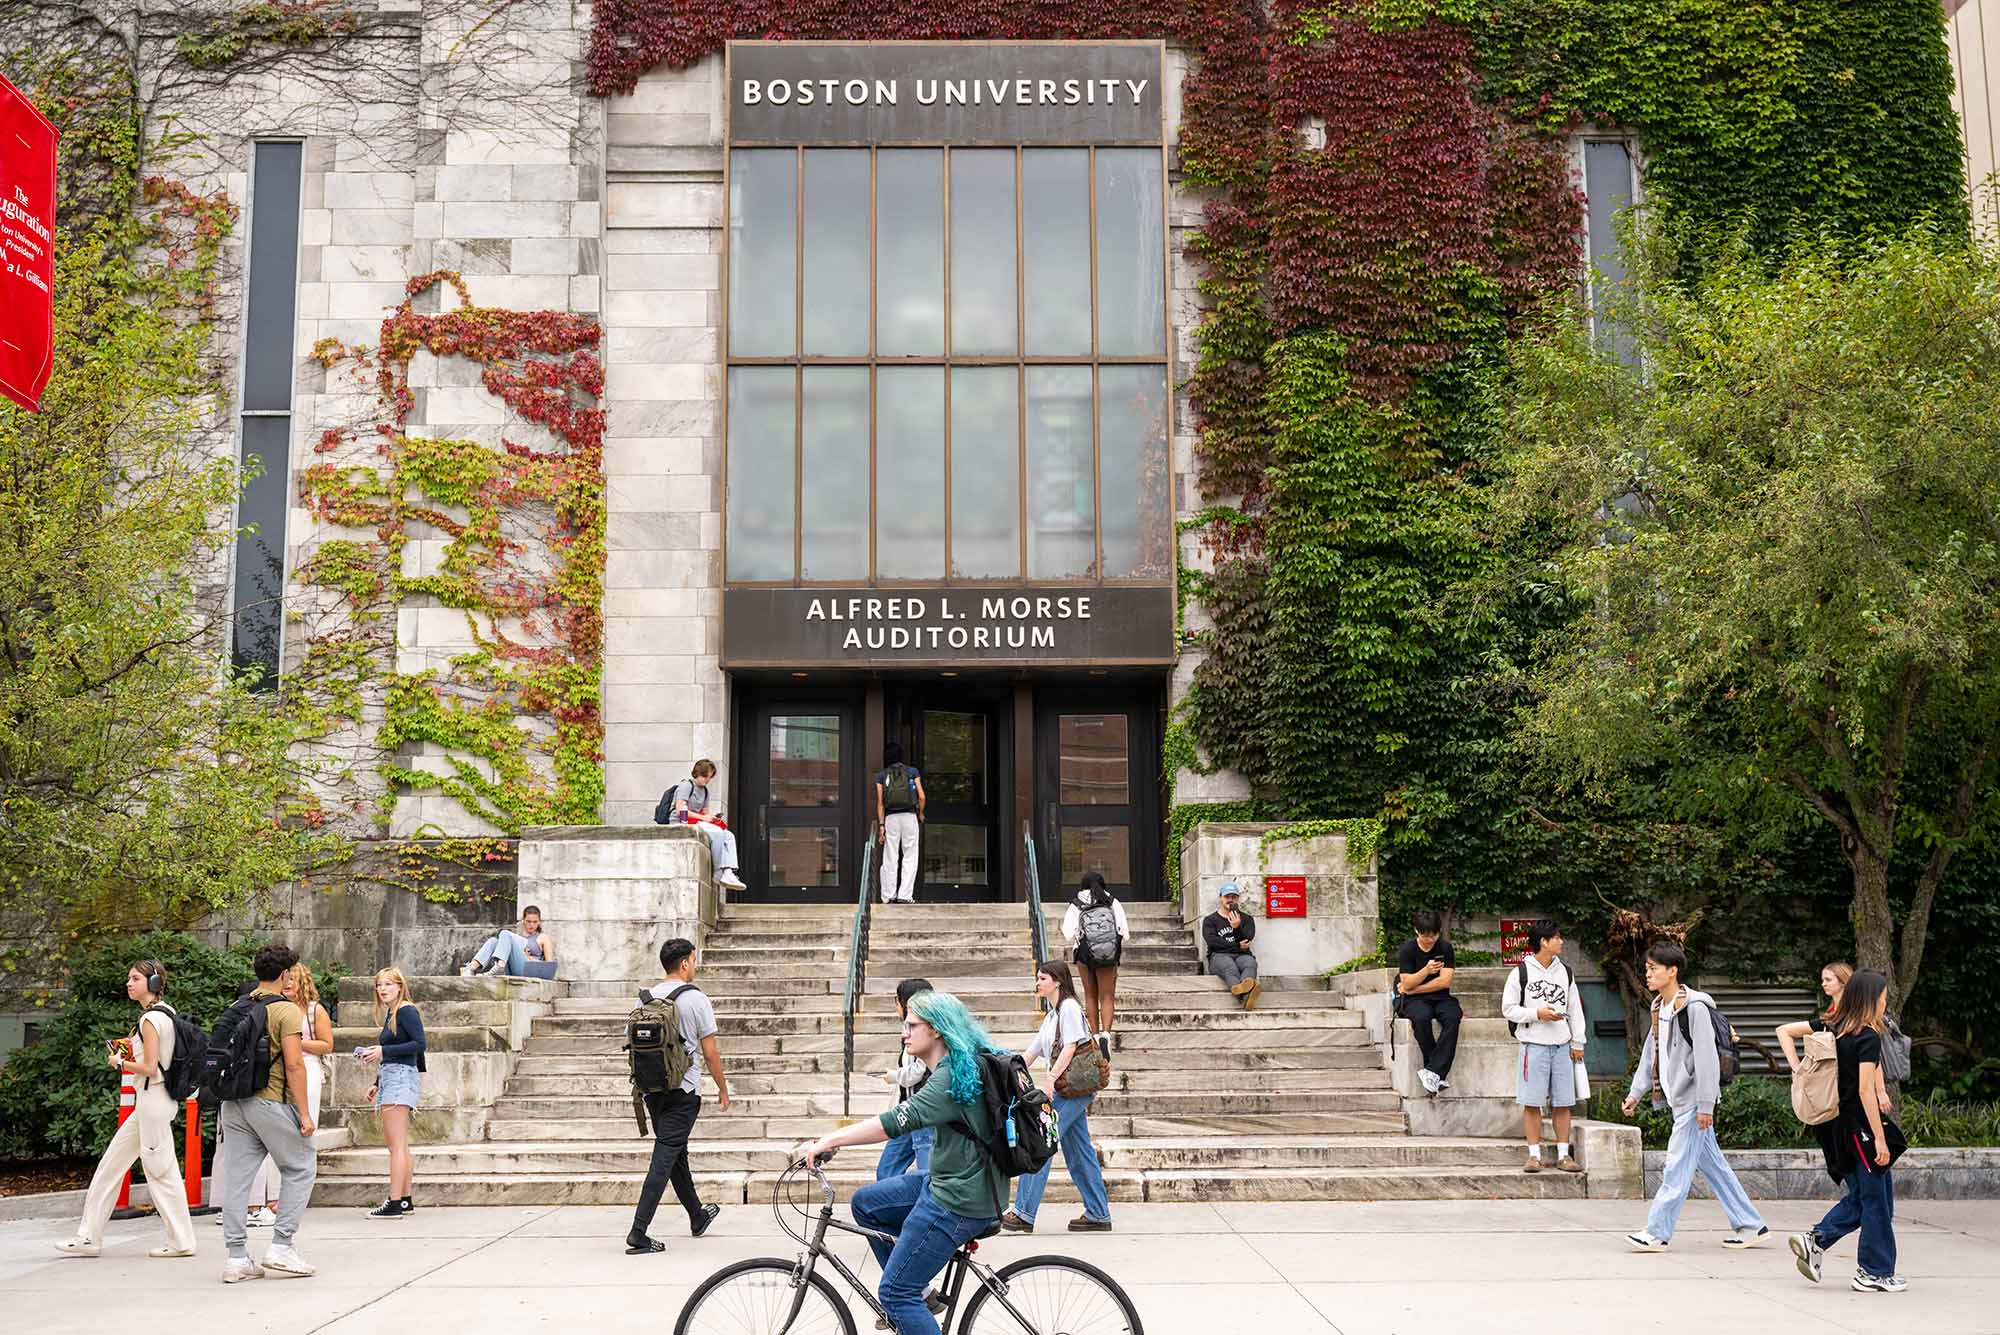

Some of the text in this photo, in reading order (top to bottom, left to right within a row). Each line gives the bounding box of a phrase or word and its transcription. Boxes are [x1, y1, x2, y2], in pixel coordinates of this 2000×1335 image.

[744, 80, 1147, 103] BOSTON UNIVERSITY
[14, 185, 28, 206] The
[807, 598, 1090, 619] ALFRED L. MORSE
[843, 627, 1054, 648] AUDITORIUM
